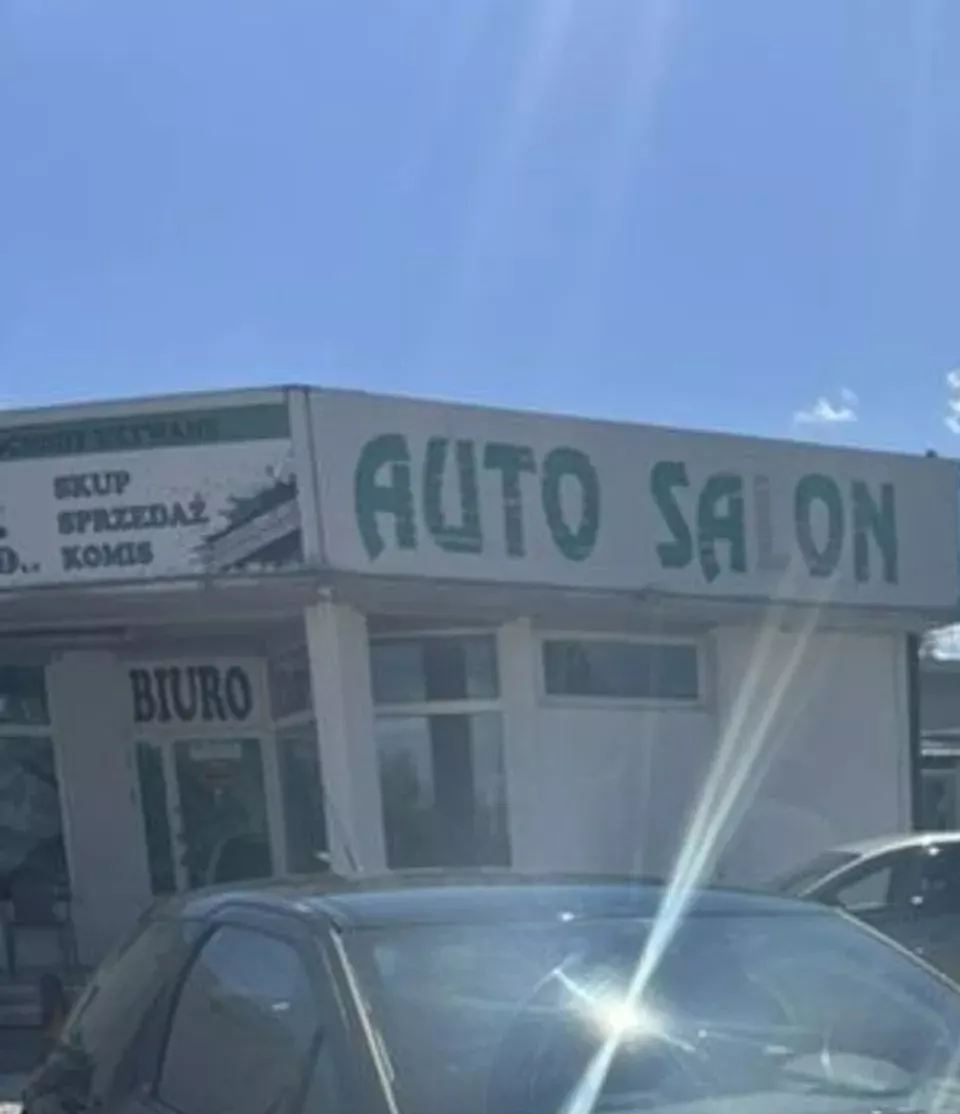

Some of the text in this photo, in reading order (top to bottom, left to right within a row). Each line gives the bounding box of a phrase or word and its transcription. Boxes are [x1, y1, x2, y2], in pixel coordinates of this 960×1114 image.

[53, 469, 131, 500] SKUP
[354, 433, 898, 584] AUTO SALON
[60, 541, 154, 572] KOMIS
[129, 665, 252, 724] BIURO
